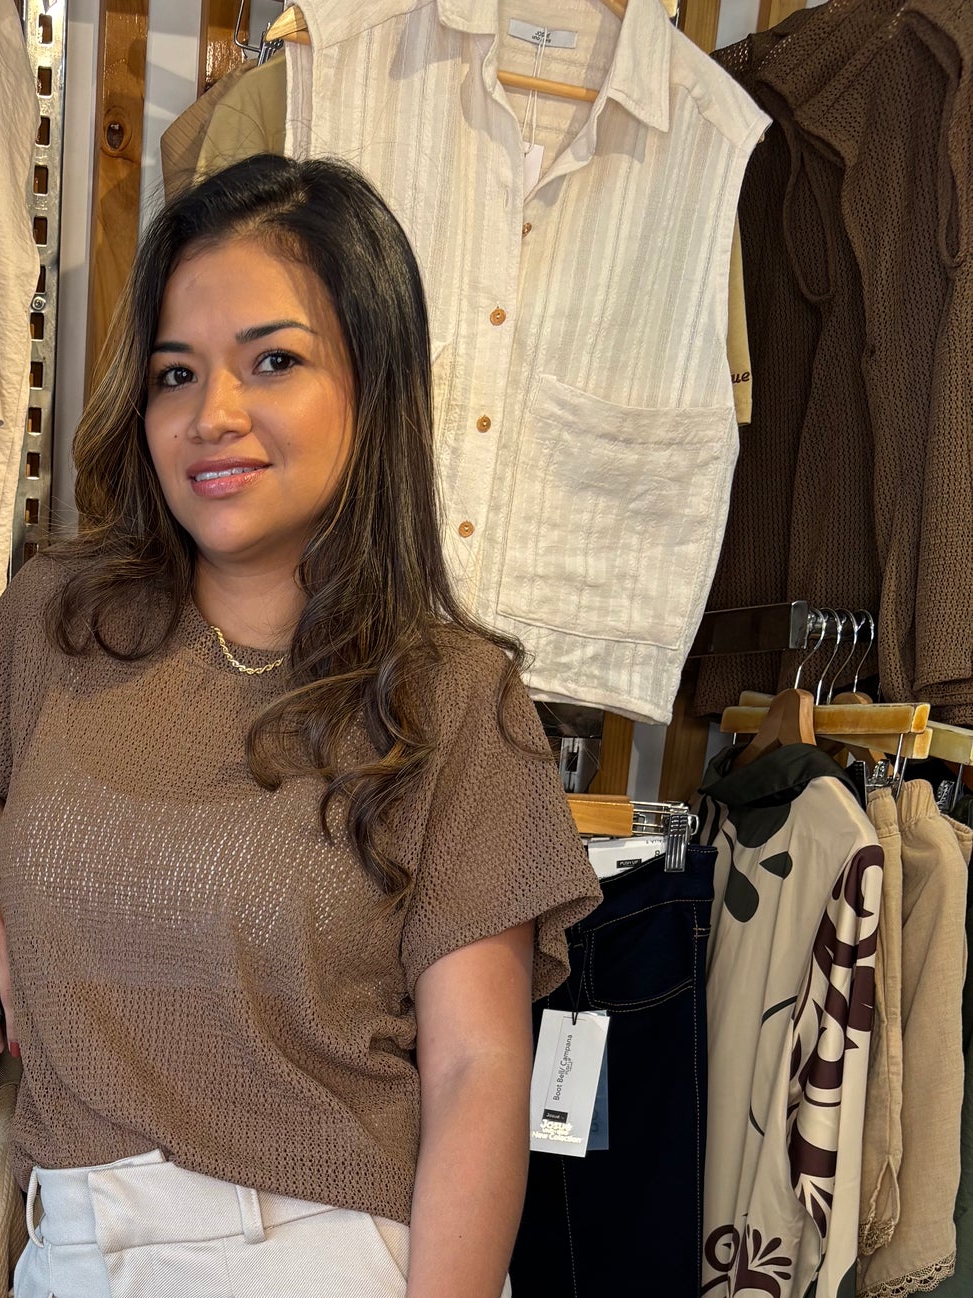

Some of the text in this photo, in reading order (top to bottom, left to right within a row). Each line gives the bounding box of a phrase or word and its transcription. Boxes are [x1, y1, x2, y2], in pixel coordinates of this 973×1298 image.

[553, 1084, 563, 1101] Boot
[560, 1034, 573, 1066] Campana
[531, 1130, 549, 1140] New
